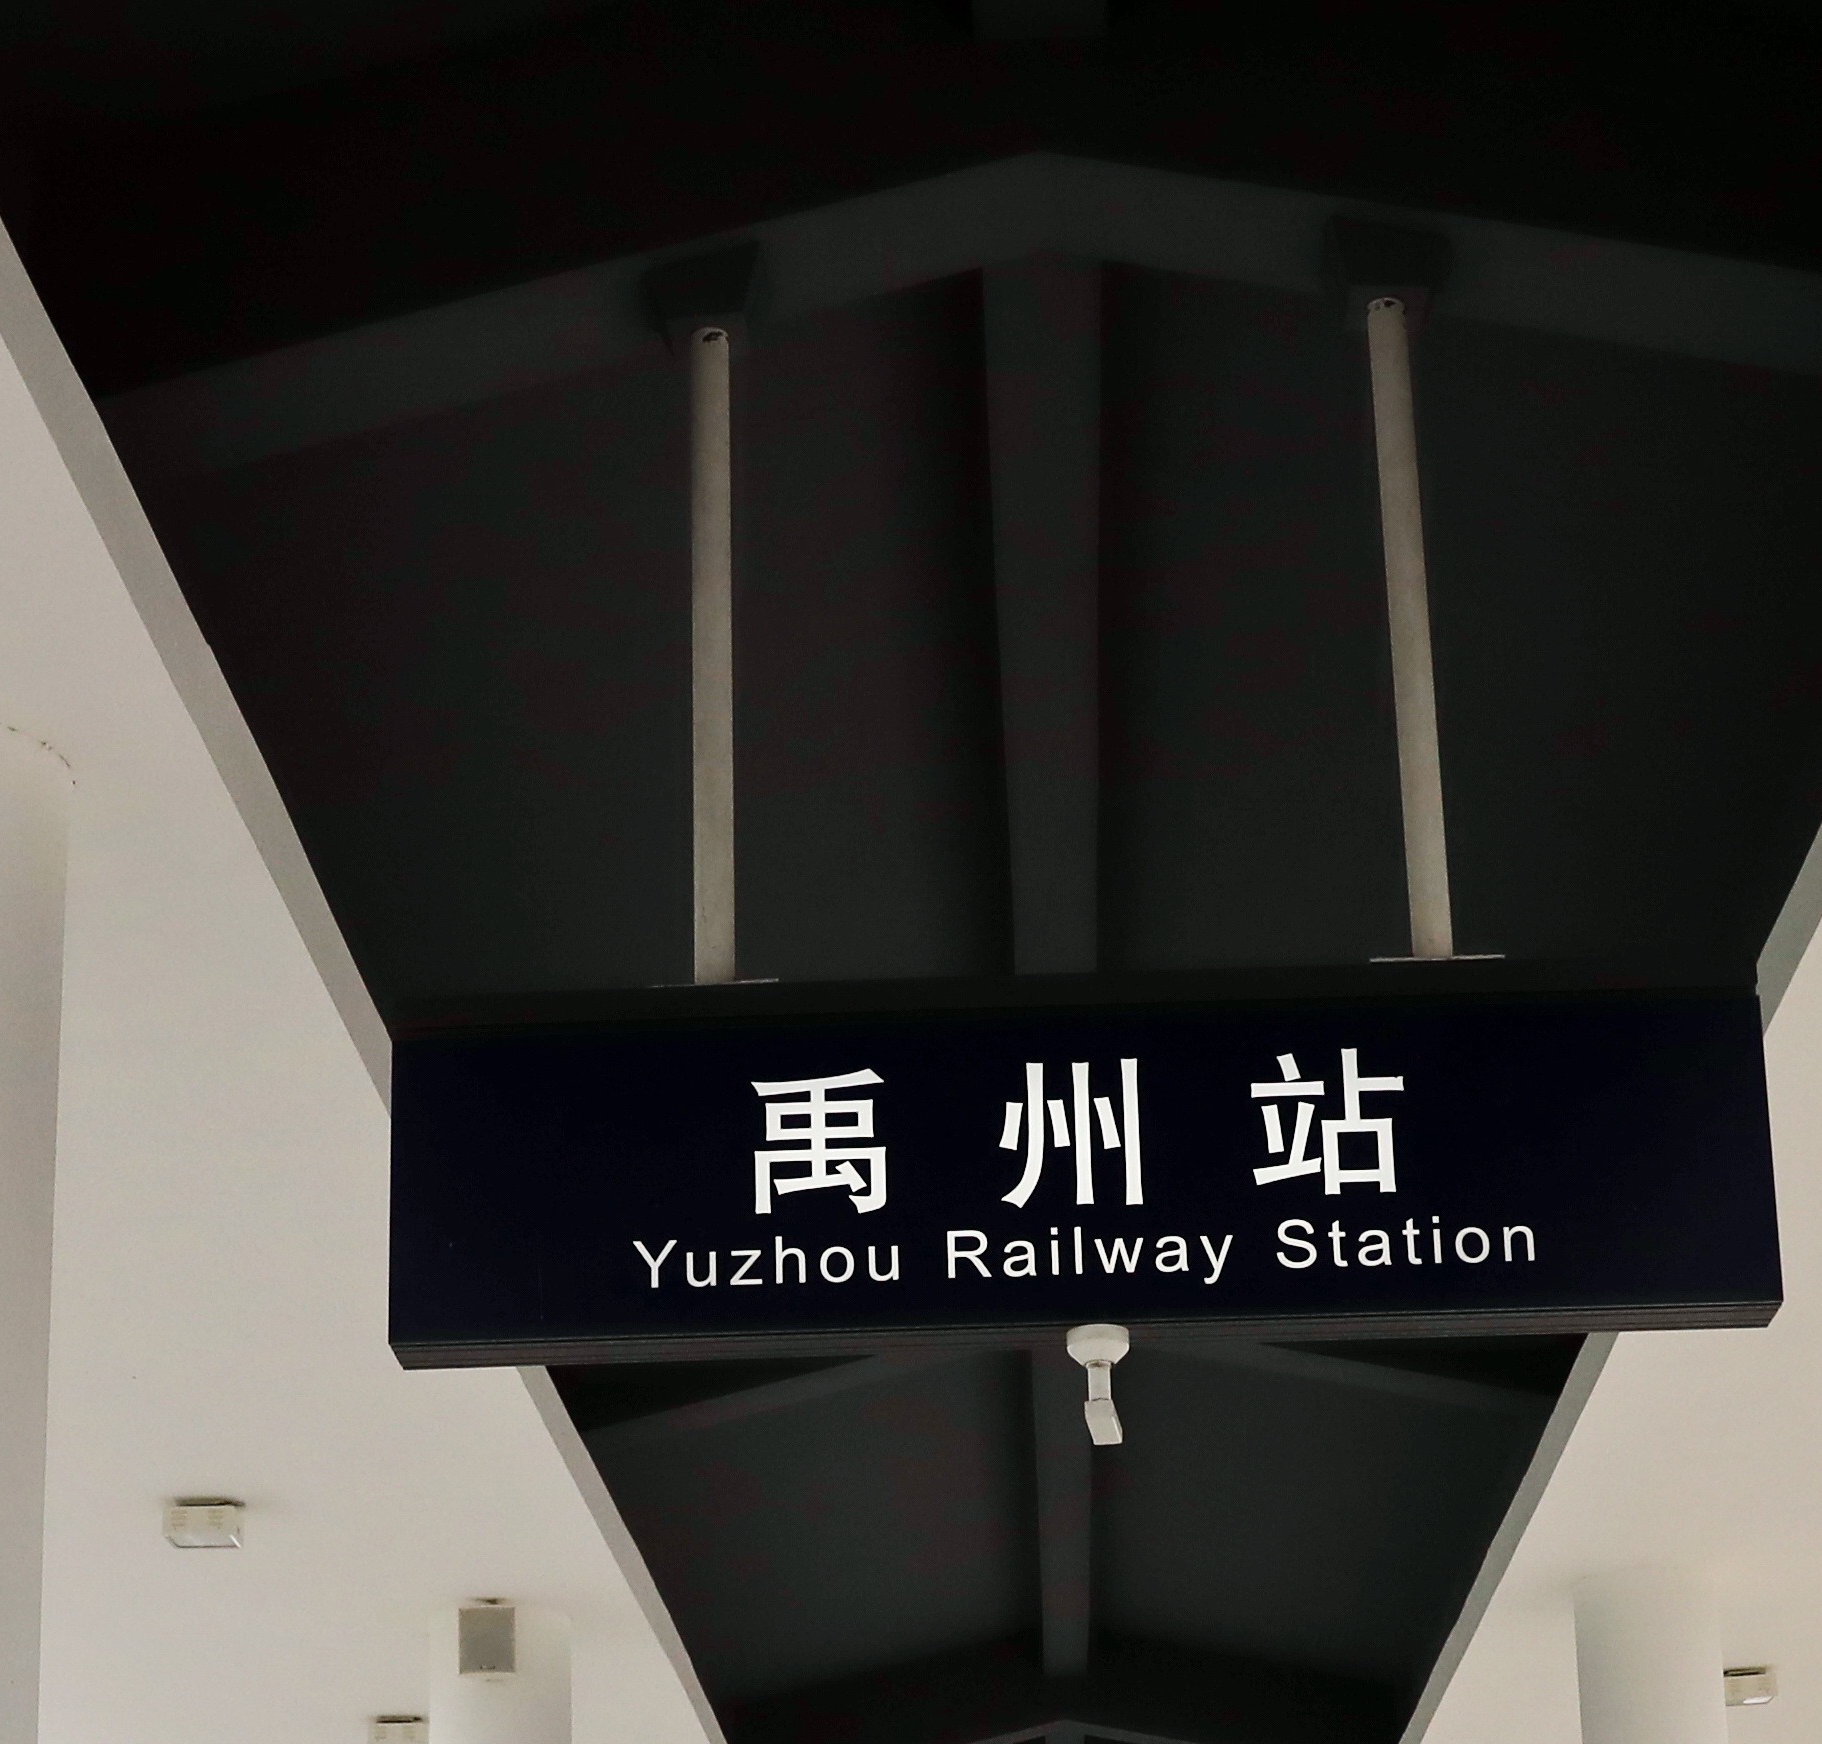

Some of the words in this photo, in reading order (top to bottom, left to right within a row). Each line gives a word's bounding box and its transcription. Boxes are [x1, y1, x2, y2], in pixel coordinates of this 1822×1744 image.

[750, 1047, 1405, 1215] 禹州站
[631, 1235, 901, 1289] Yuzhou
[946, 1226, 1234, 1285] Railway
[1276, 1215, 1537, 1269] Station
